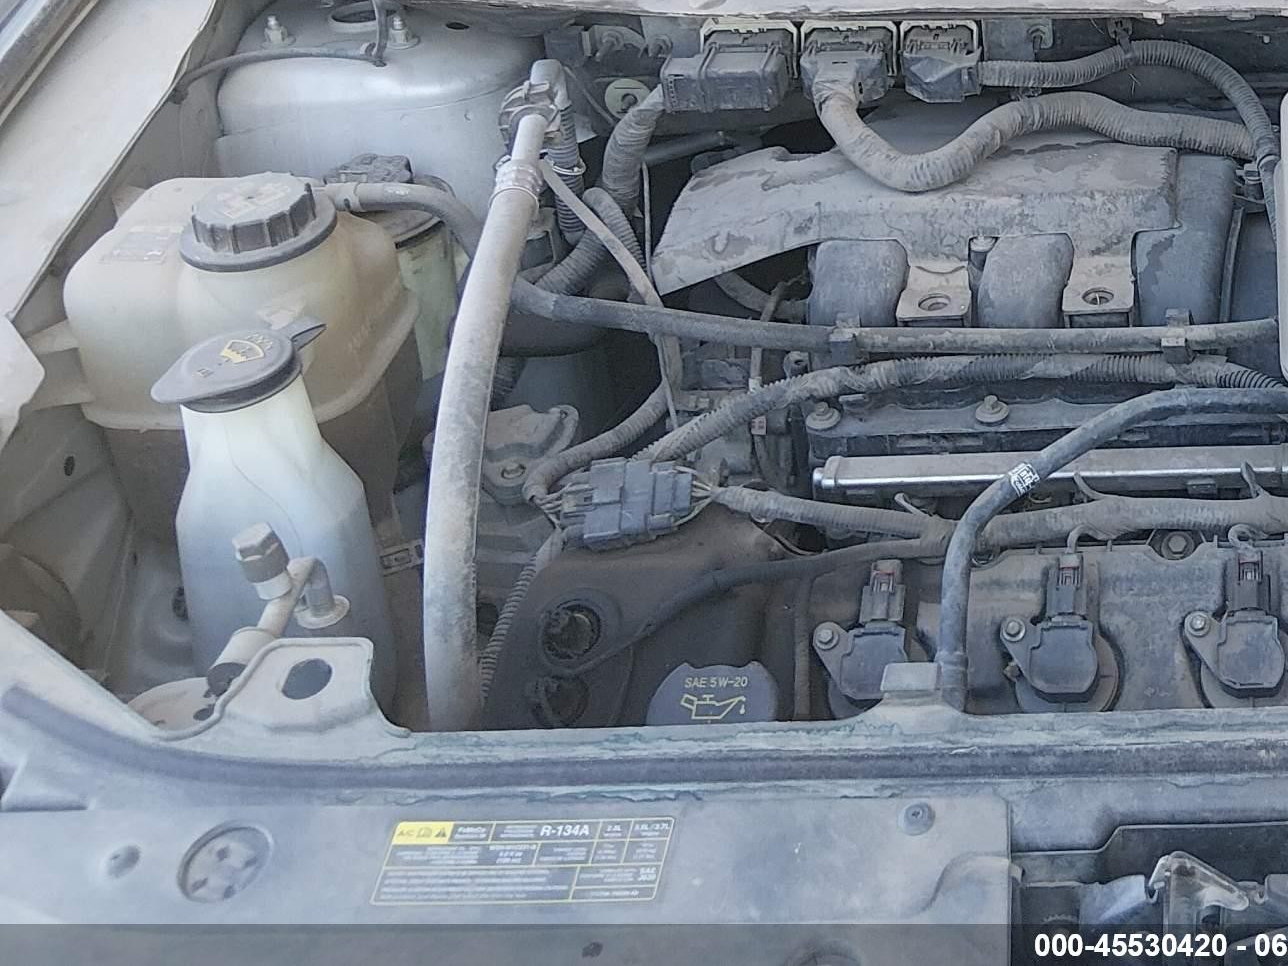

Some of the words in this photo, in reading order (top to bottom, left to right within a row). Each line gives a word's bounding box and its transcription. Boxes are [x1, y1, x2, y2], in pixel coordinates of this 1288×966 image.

[684, 676, 708, 689] SAE
[710, 676, 748, 688] 5W-20
[540, 824, 590, 836] R-134A
